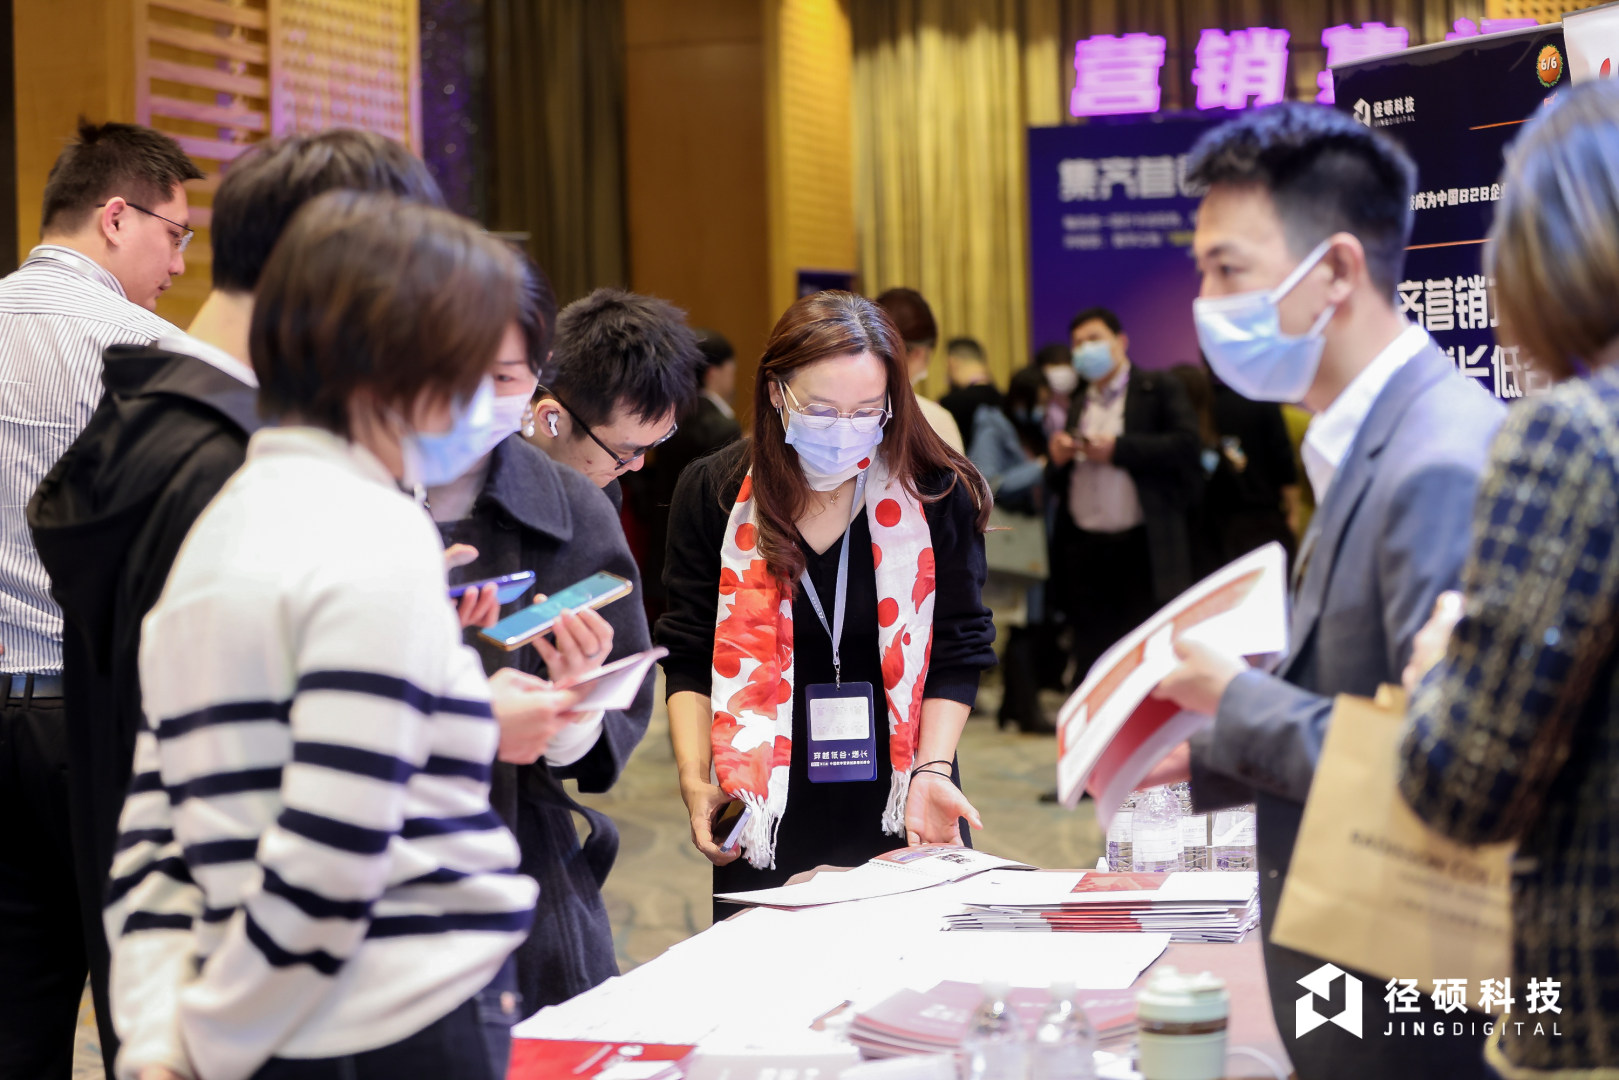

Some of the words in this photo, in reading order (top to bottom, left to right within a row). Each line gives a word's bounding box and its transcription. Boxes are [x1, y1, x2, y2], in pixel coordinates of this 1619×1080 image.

[1541, 57, 1557, 70] 6/6
[1373, 96, 1415, 118] 径硕科技
[1397, 274, 1497, 332] 齐营销
